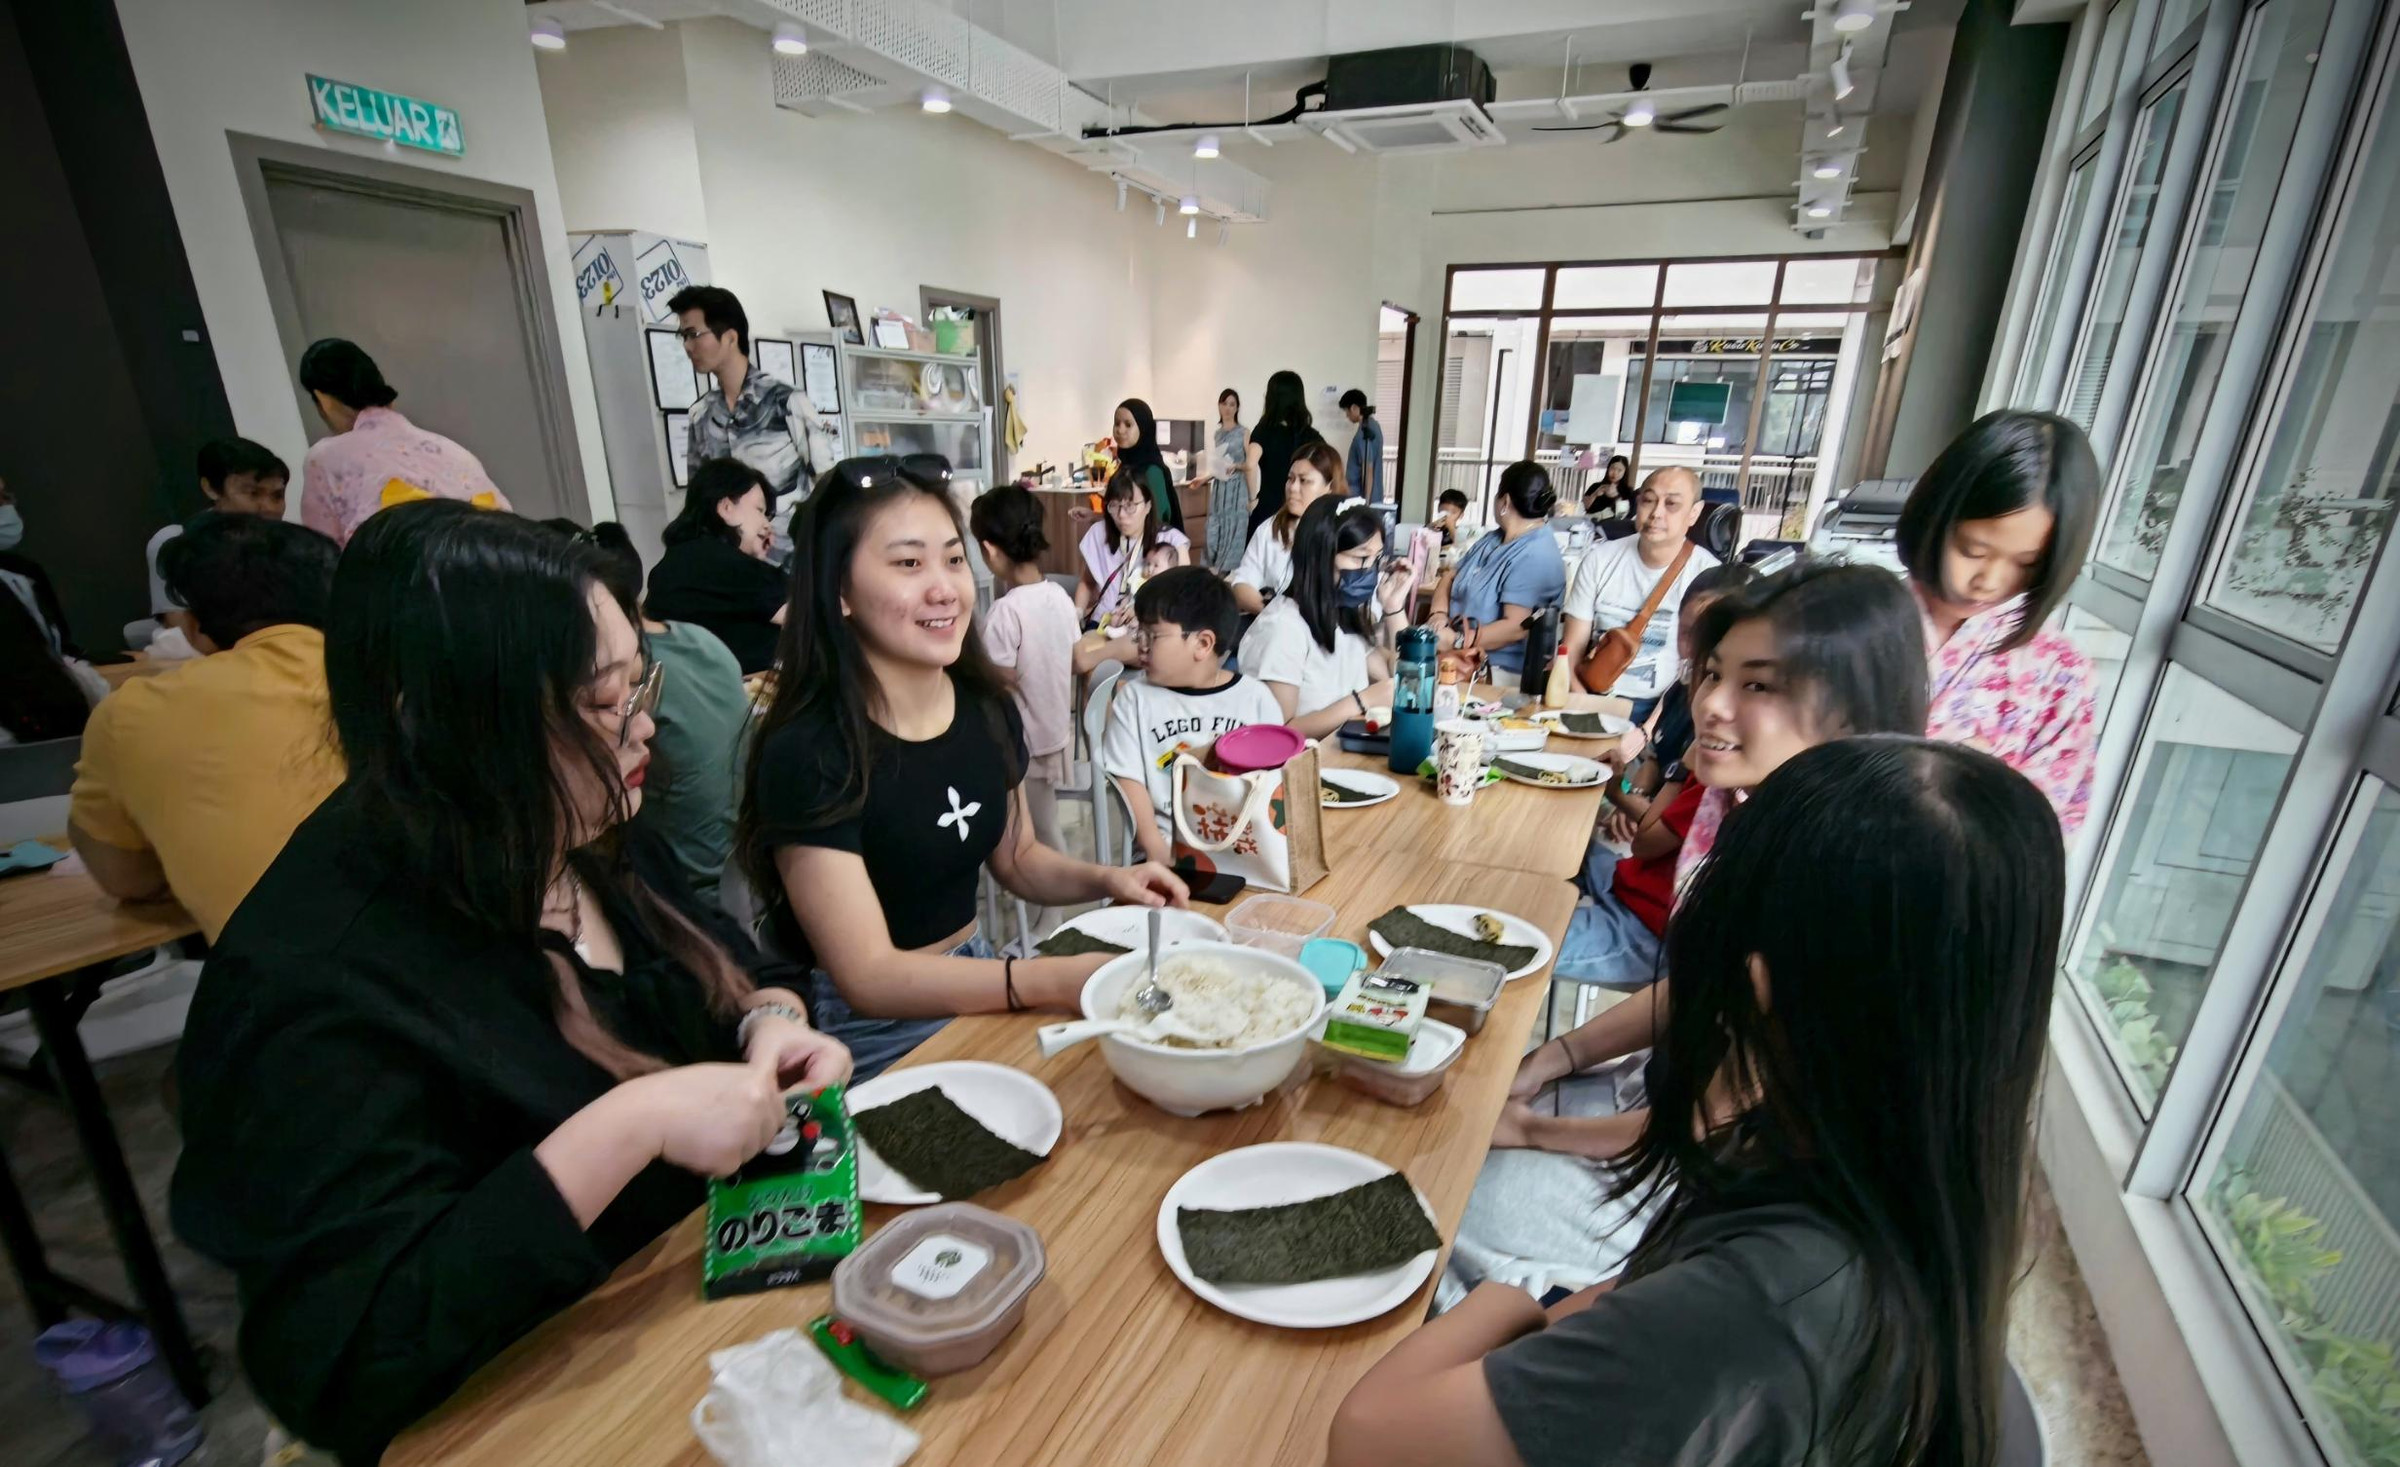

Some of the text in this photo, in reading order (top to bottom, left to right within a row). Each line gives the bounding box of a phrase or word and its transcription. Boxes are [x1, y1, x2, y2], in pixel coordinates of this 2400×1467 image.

[312, 79, 433, 145] KELUAR
[641, 259, 681, 300] 0123
[1152, 717, 1200, 743] LEGO
[718, 1201, 846, 1252] のりごま
